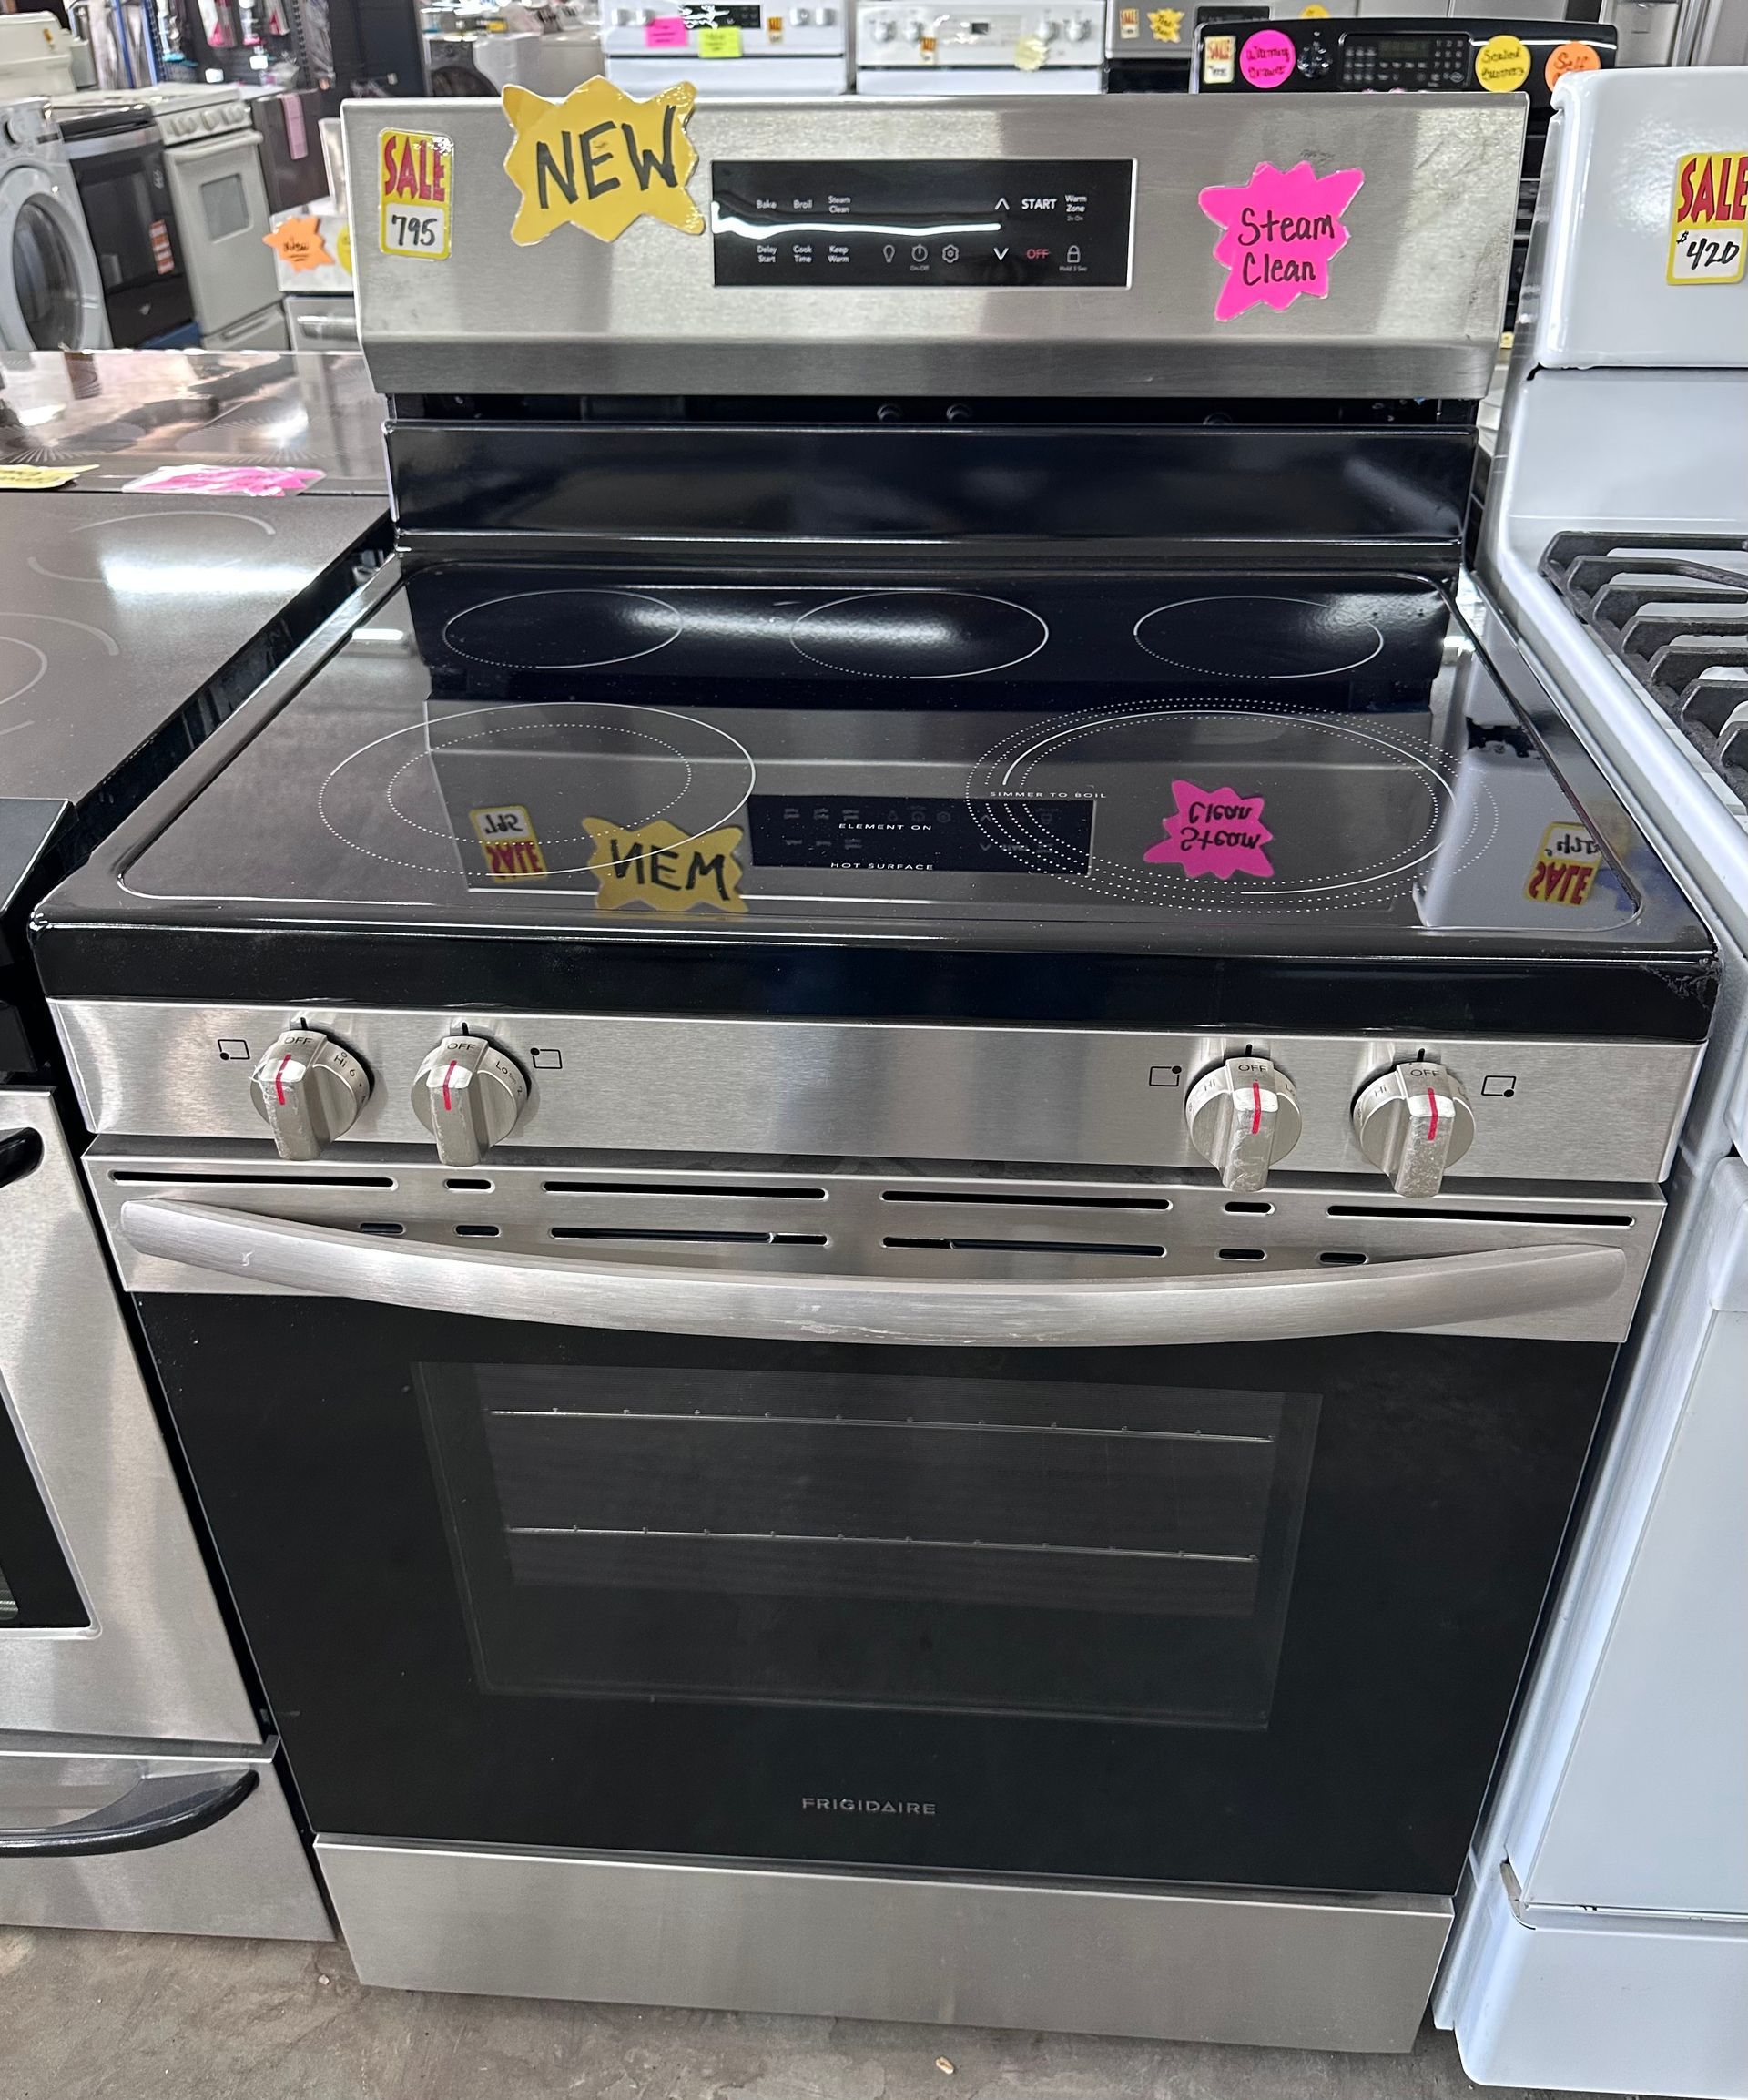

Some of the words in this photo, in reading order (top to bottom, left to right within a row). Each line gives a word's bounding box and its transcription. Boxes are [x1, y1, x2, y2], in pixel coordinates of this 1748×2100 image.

[537, 105, 678, 209] NEW
[384, 136, 445, 202] SALE
[1677, 155, 1748, 223] SALE
[828, 195, 851, 204] Steam
[1065, 194, 1088, 203] Warm
[756, 199, 777, 209] Bake
[793, 199, 813, 209] Broil
[1021, 199, 1058, 209] START
[1066, 203, 1086, 212] Zone
[828, 205, 850, 214] Clean
[391, 215, 438, 246] 795
[1238, 207, 1335, 246] Steam
[757, 245, 778, 255] Delay
[792, 245, 813, 254] Cook
[829, 245, 849, 255] Keep
[1026, 249, 1050, 260] OFF
[757, 255, 776, 263] Start
[794, 255, 812, 263] Time
[827, 255, 850, 263] Warm
[1243, 251, 1316, 286] Clean
[868, 862, 933, 871] SURFACE
[284, 1036, 313, 1045] OFF
[333, 1055, 346, 1067] Hi
[495, 1060, 508, 1075] Lo
[1238, 1064, 1267, 1072] OFF
[1410, 1068, 1440, 1077] OFF
[1204, 1078, 1216, 1092] Hi
[1374, 1084, 1387, 1097] Hi
[801, 1797, 936, 1815] FRIGIDAIRE
